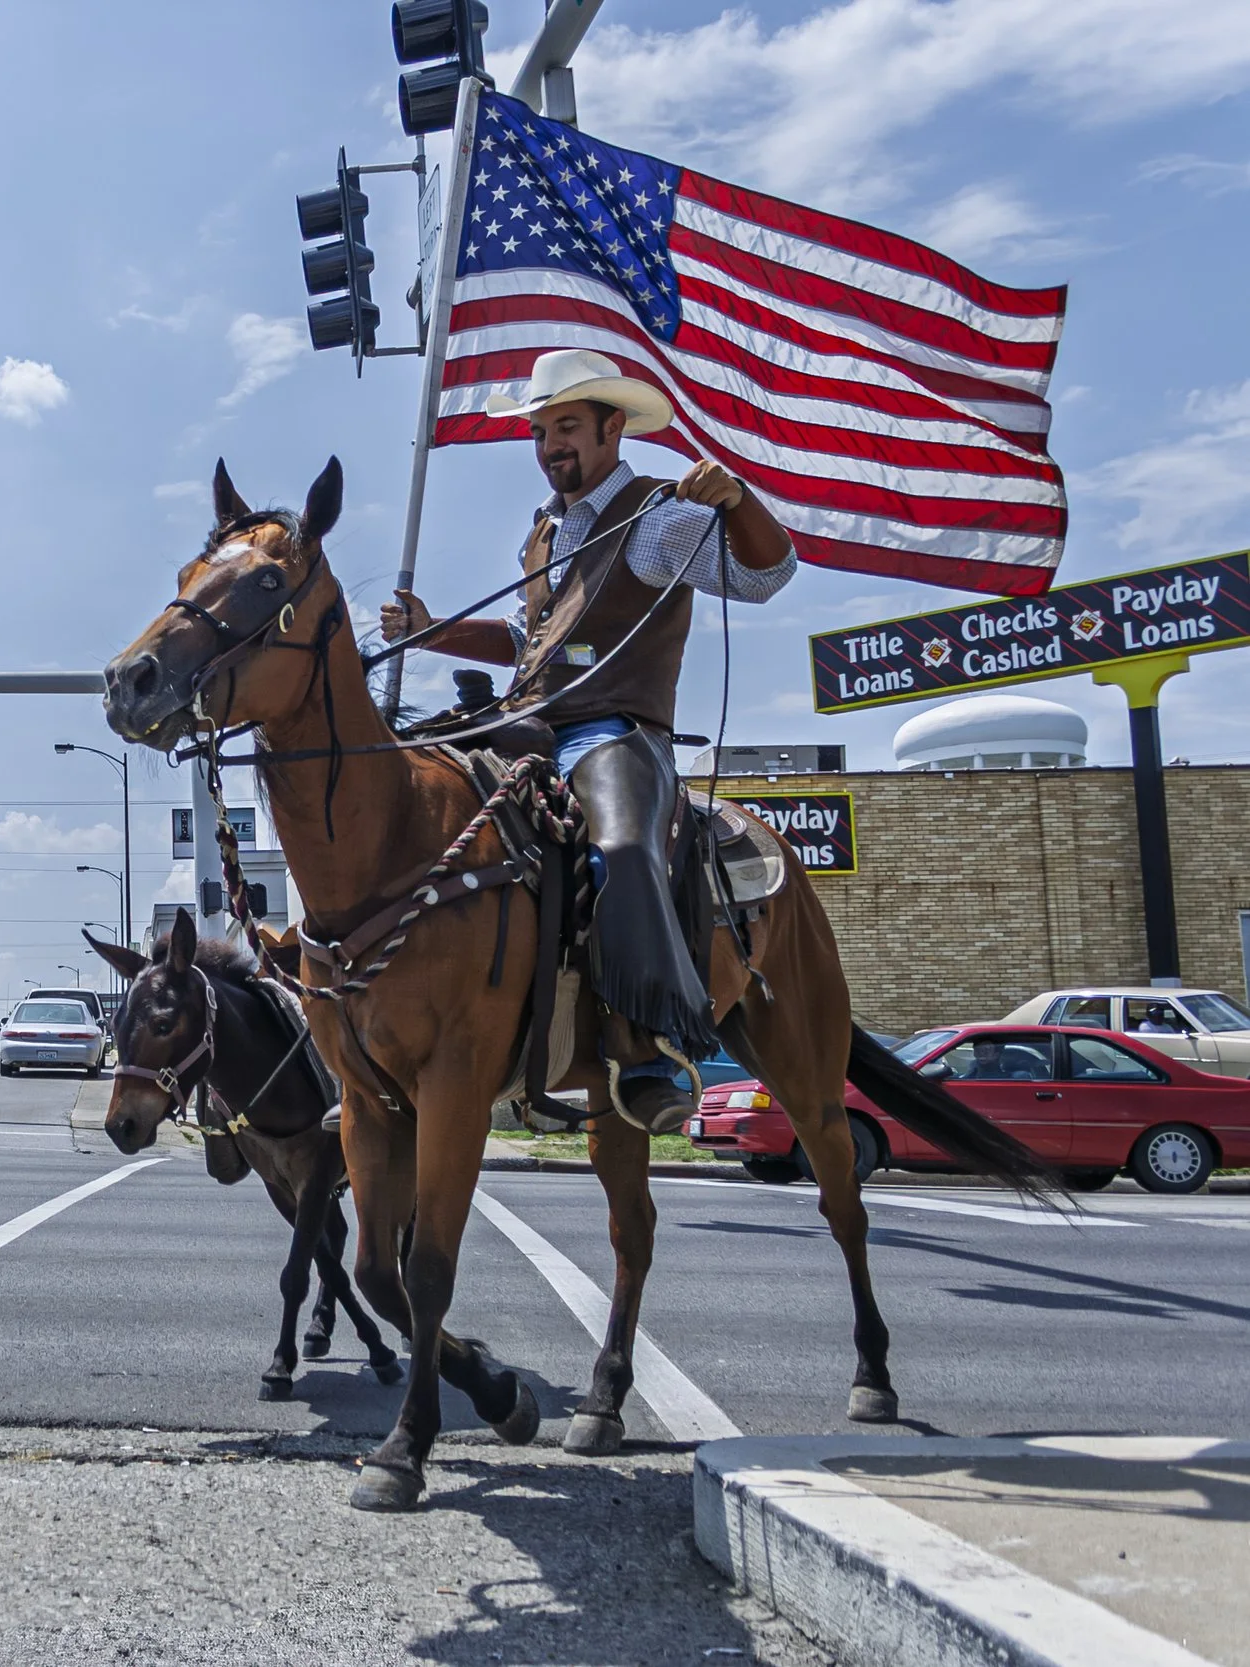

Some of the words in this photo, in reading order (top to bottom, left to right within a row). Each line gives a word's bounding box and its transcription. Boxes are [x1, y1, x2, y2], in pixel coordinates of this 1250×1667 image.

[1112, 575, 1220, 615] Payday
[961, 604, 1058, 642] Checks
[1123, 615, 1215, 650] Loans
[843, 632, 904, 663] Title
[962, 635, 1062, 677] Cashed
[838, 668, 914, 699] Loans
